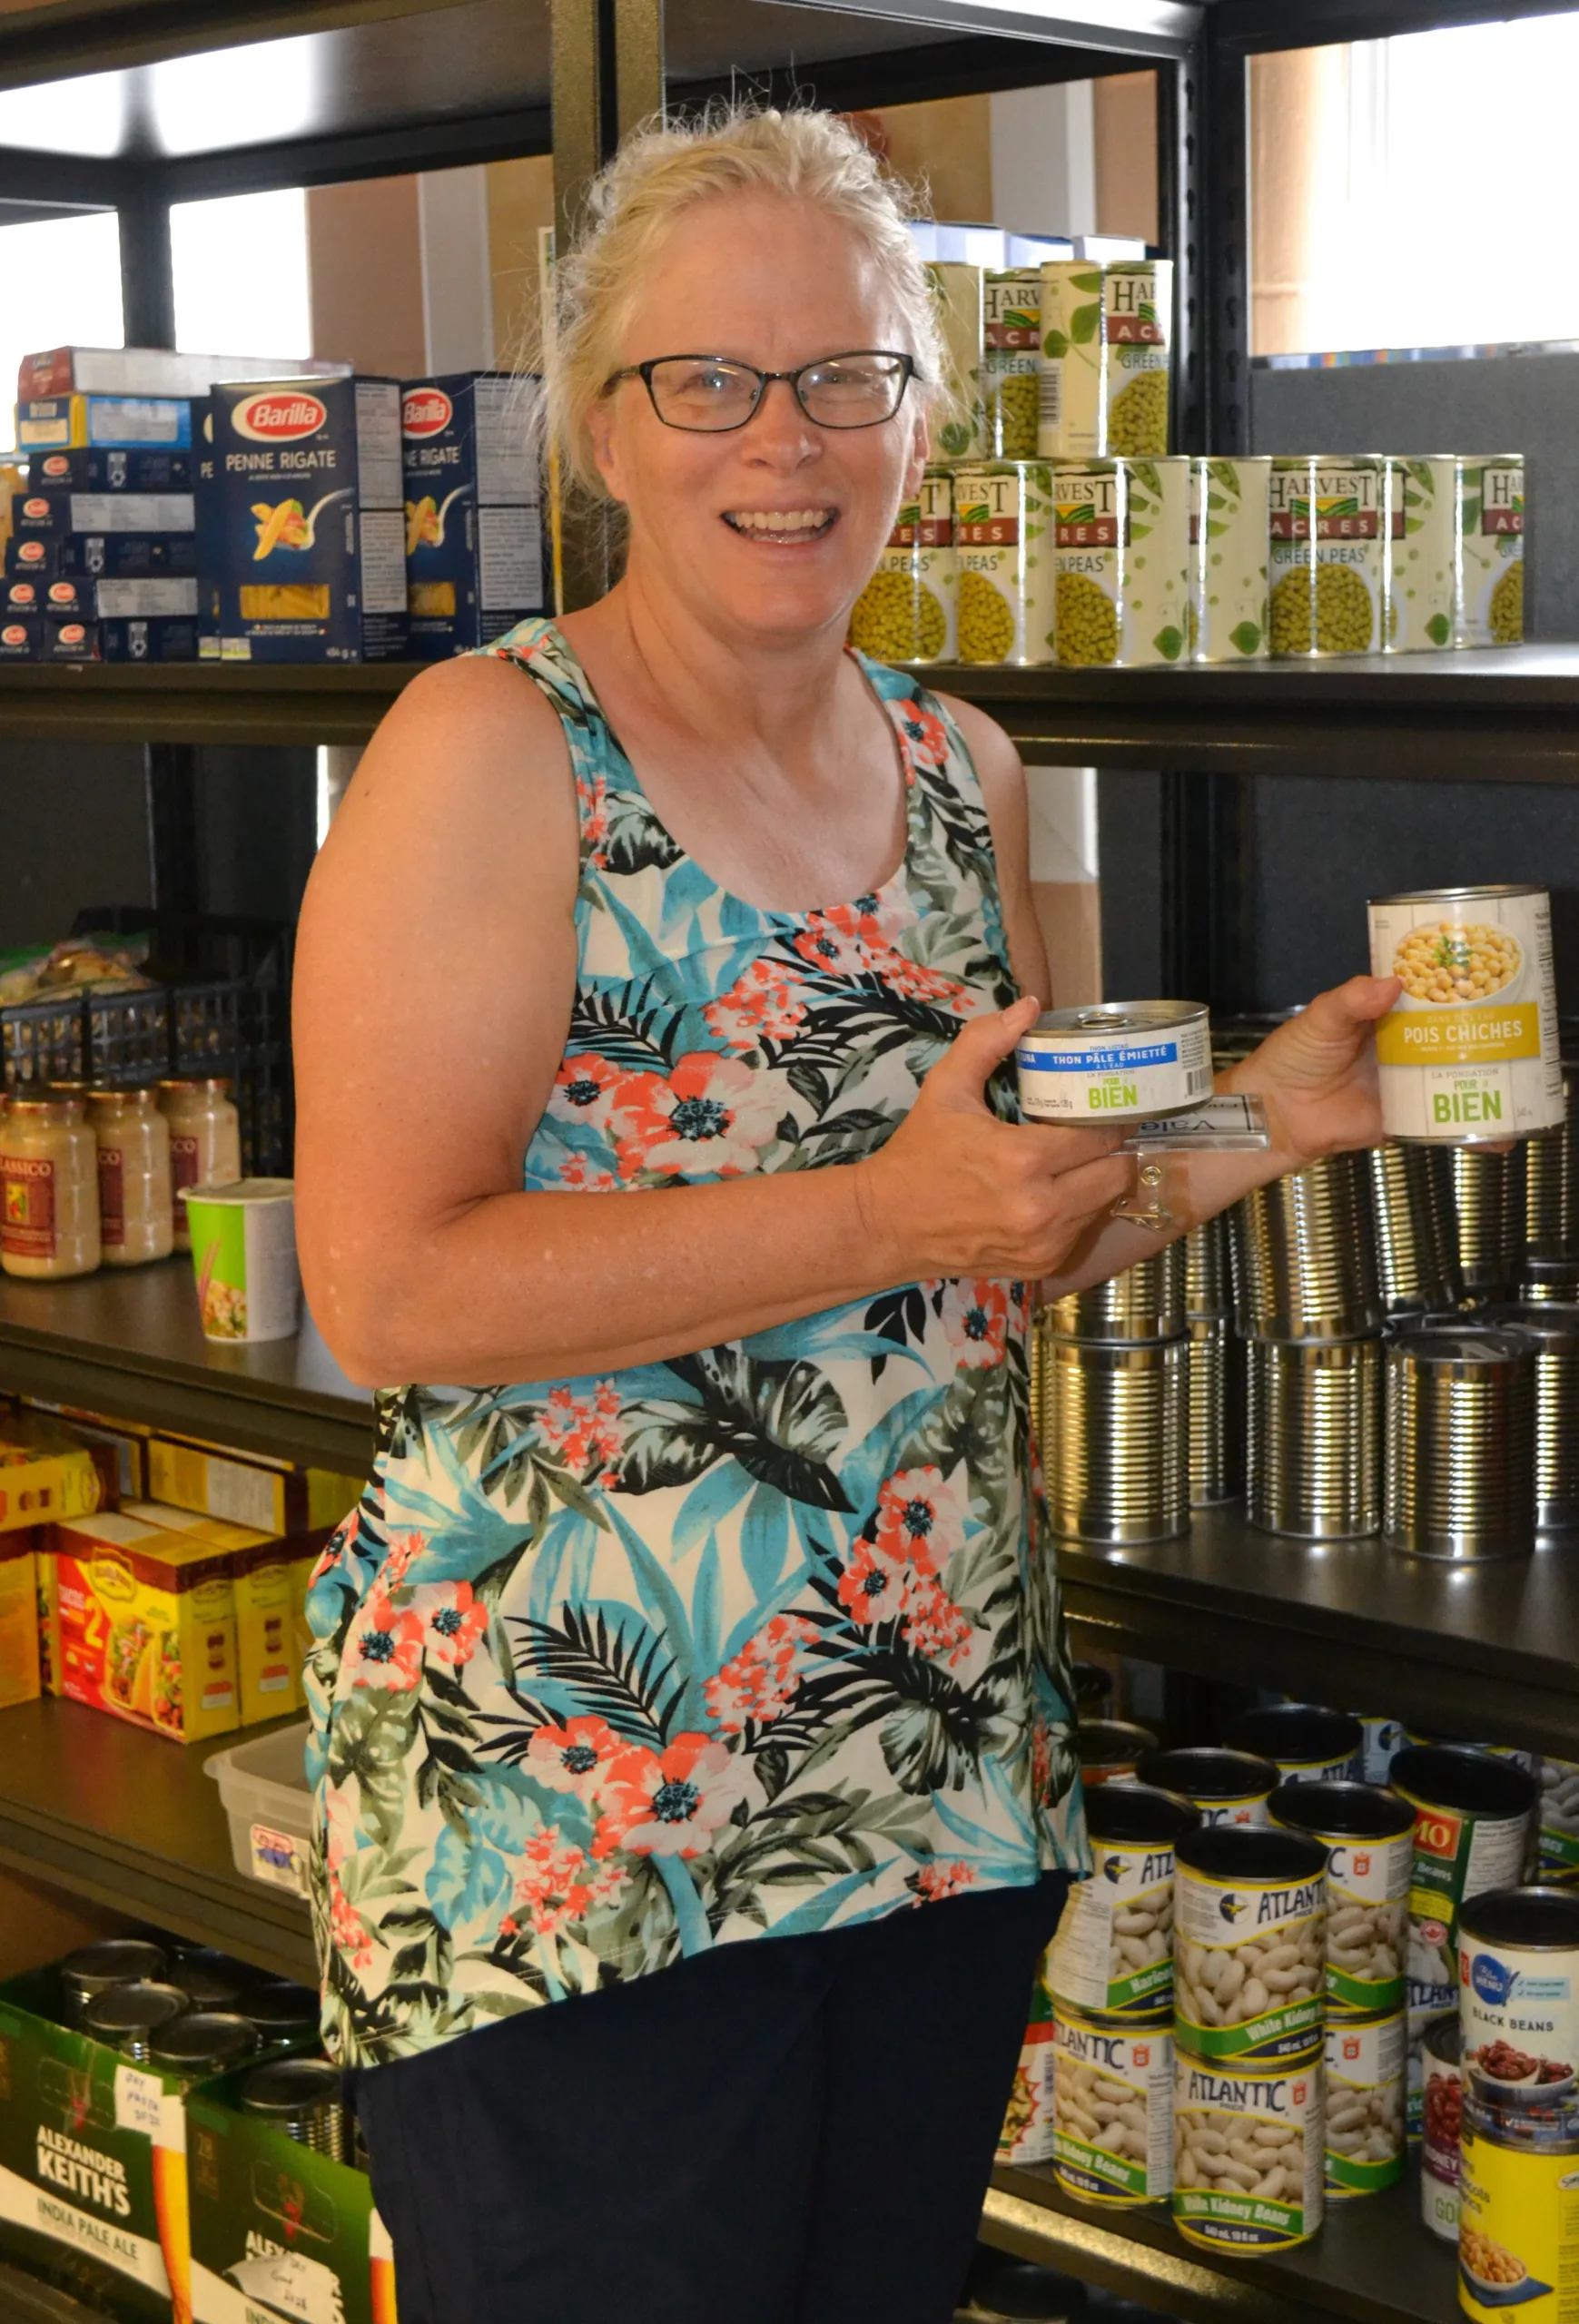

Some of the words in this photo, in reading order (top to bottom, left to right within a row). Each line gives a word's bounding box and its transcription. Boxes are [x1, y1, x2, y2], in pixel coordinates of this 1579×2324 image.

[252, 401, 319, 428] Barilla
[404, 399, 447, 424] Barilla
[225, 453, 275, 473] PENNE
[280, 449, 337, 469] RIGATE
[420, 447, 461, 466] RIGATE
[1269, 476, 1372, 507] HARVEST
[1271, 519, 1369, 535] ACRES
[891, 556, 930, 572] PEAS
[966, 555, 999, 572] PEAS
[1070, 556, 1105, 573] PEAS
[1273, 547, 1325, 564] GREEN
[1329, 547, 1366, 564] PEAS
[1404, 1026, 1440, 1044] POIS
[1446, 1019, 1524, 1042] CHICHES
[1052, 1055, 1082, 1065] THON
[1086, 1051, 1115, 1064] PÂLE
[1119, 1045, 1168, 1062] ÉMIETTÉ
[1431, 1071, 1443, 1079] LA
[1446, 1068, 1499, 1078] FONDATION
[1455, 1079, 1477, 1090] POUR
[1088, 1084, 1139, 1109] BIEN
[1433, 1090, 1502, 1124] BIEN
[1472, 2005, 1505, 2028] BLACK
[1509, 2018, 1555, 2033] BEANS
[1188, 2069, 1286, 2112] ATLANTIC
[37, 2123, 126, 2184] ALEXANDER
[37, 2145, 132, 2218] KEITH'S
[1210, 2196, 1252, 2221] Kidney
[37, 2197, 74, 2228] INDIA
[77, 2216, 110, 2248] PALE
[113, 2234, 138, 2260] ALE
